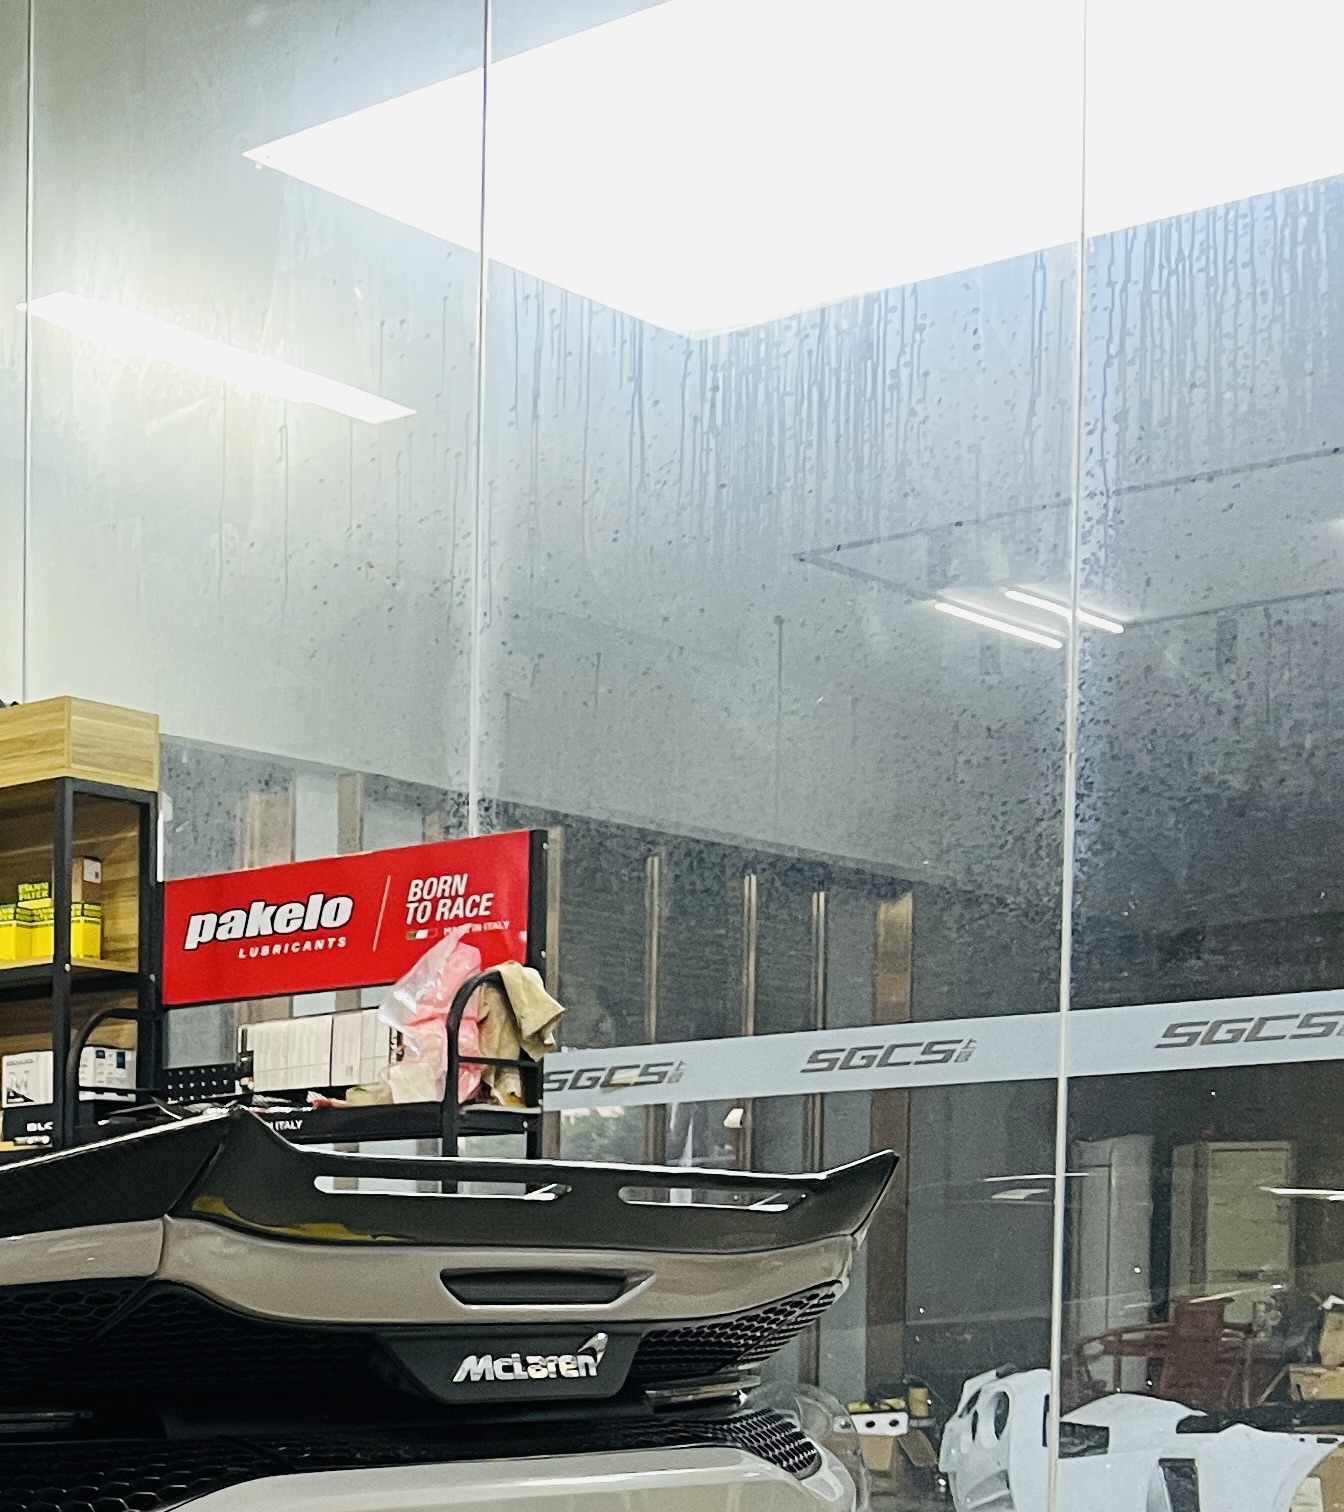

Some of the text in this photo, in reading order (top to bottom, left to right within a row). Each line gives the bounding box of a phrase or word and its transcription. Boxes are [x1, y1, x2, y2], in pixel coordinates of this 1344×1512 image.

[407, 873, 470, 902] BORN
[184, 893, 354, 950] pakelo
[406, 893, 494, 925] TO RACE
[238, 936, 347, 959] LUBRICANTS
[1154, 1010, 1344, 1049] SGCS
[800, 1039, 964, 1073] SGCS
[544, 1062, 674, 1092] SGCS
[275, 1119, 303, 1131] ITALY
[452, 1352, 598, 1383] McLaren
